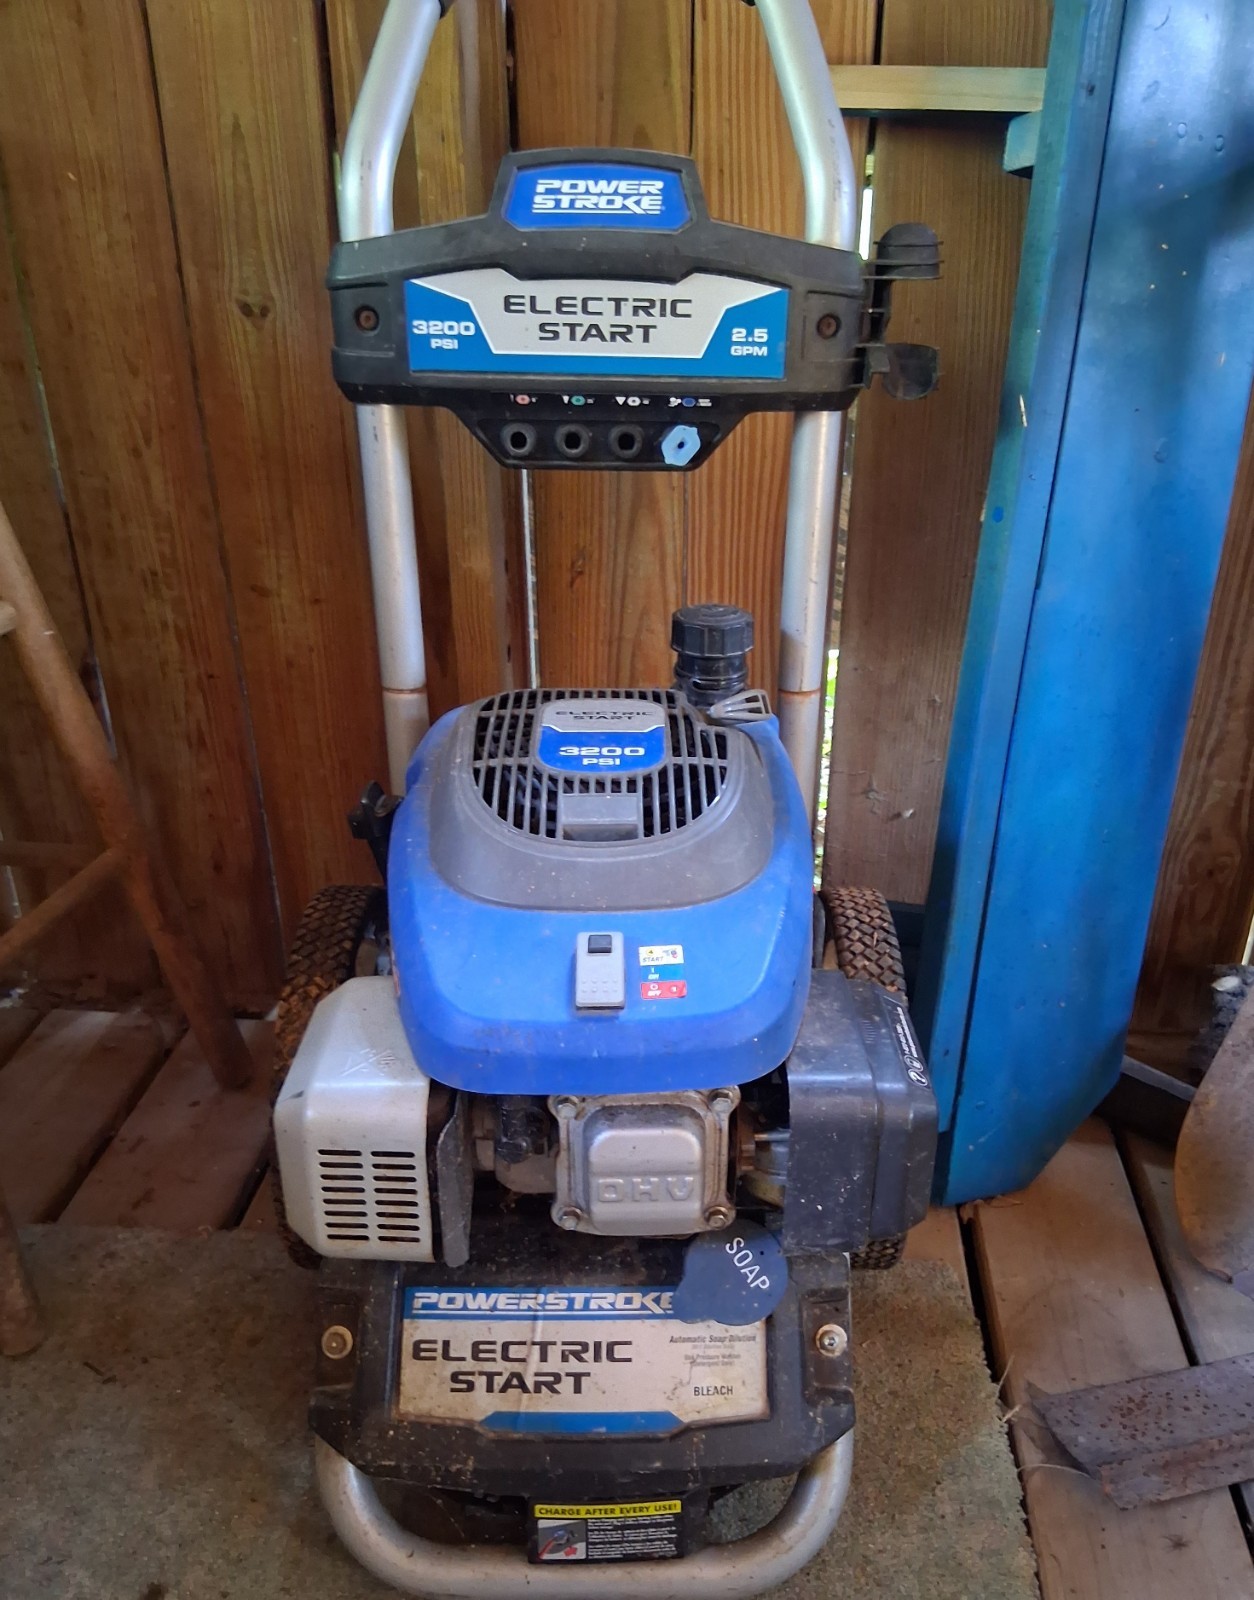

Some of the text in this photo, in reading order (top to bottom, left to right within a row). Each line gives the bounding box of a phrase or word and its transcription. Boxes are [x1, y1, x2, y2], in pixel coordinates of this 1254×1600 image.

[535, 179, 664, 194] POWER
[532, 195, 663, 214] STROKE
[503, 294, 692, 318] ELECTRIC
[412, 320, 476, 336] 3200
[538, 322, 657, 343] START
[731, 328, 769, 342] 2.5
[430, 338, 459, 350] PSI
[730, 346, 768, 356] GPM
[559, 746, 645, 756] 3200
[582, 758, 621, 766] PSI
[598, 1176, 694, 1202] OHV
[725, 1237, 770, 1290] SOAP
[412, 1339, 633, 1363] ELECTRIC
[450, 1371, 591, 1394] START
[693, 1385, 733, 1396] BLEACH
[538, 1508, 581, 1516] CHARGE
[584, 1508, 616, 1516] AFTER
[619, 1506, 651, 1514] EVERY
